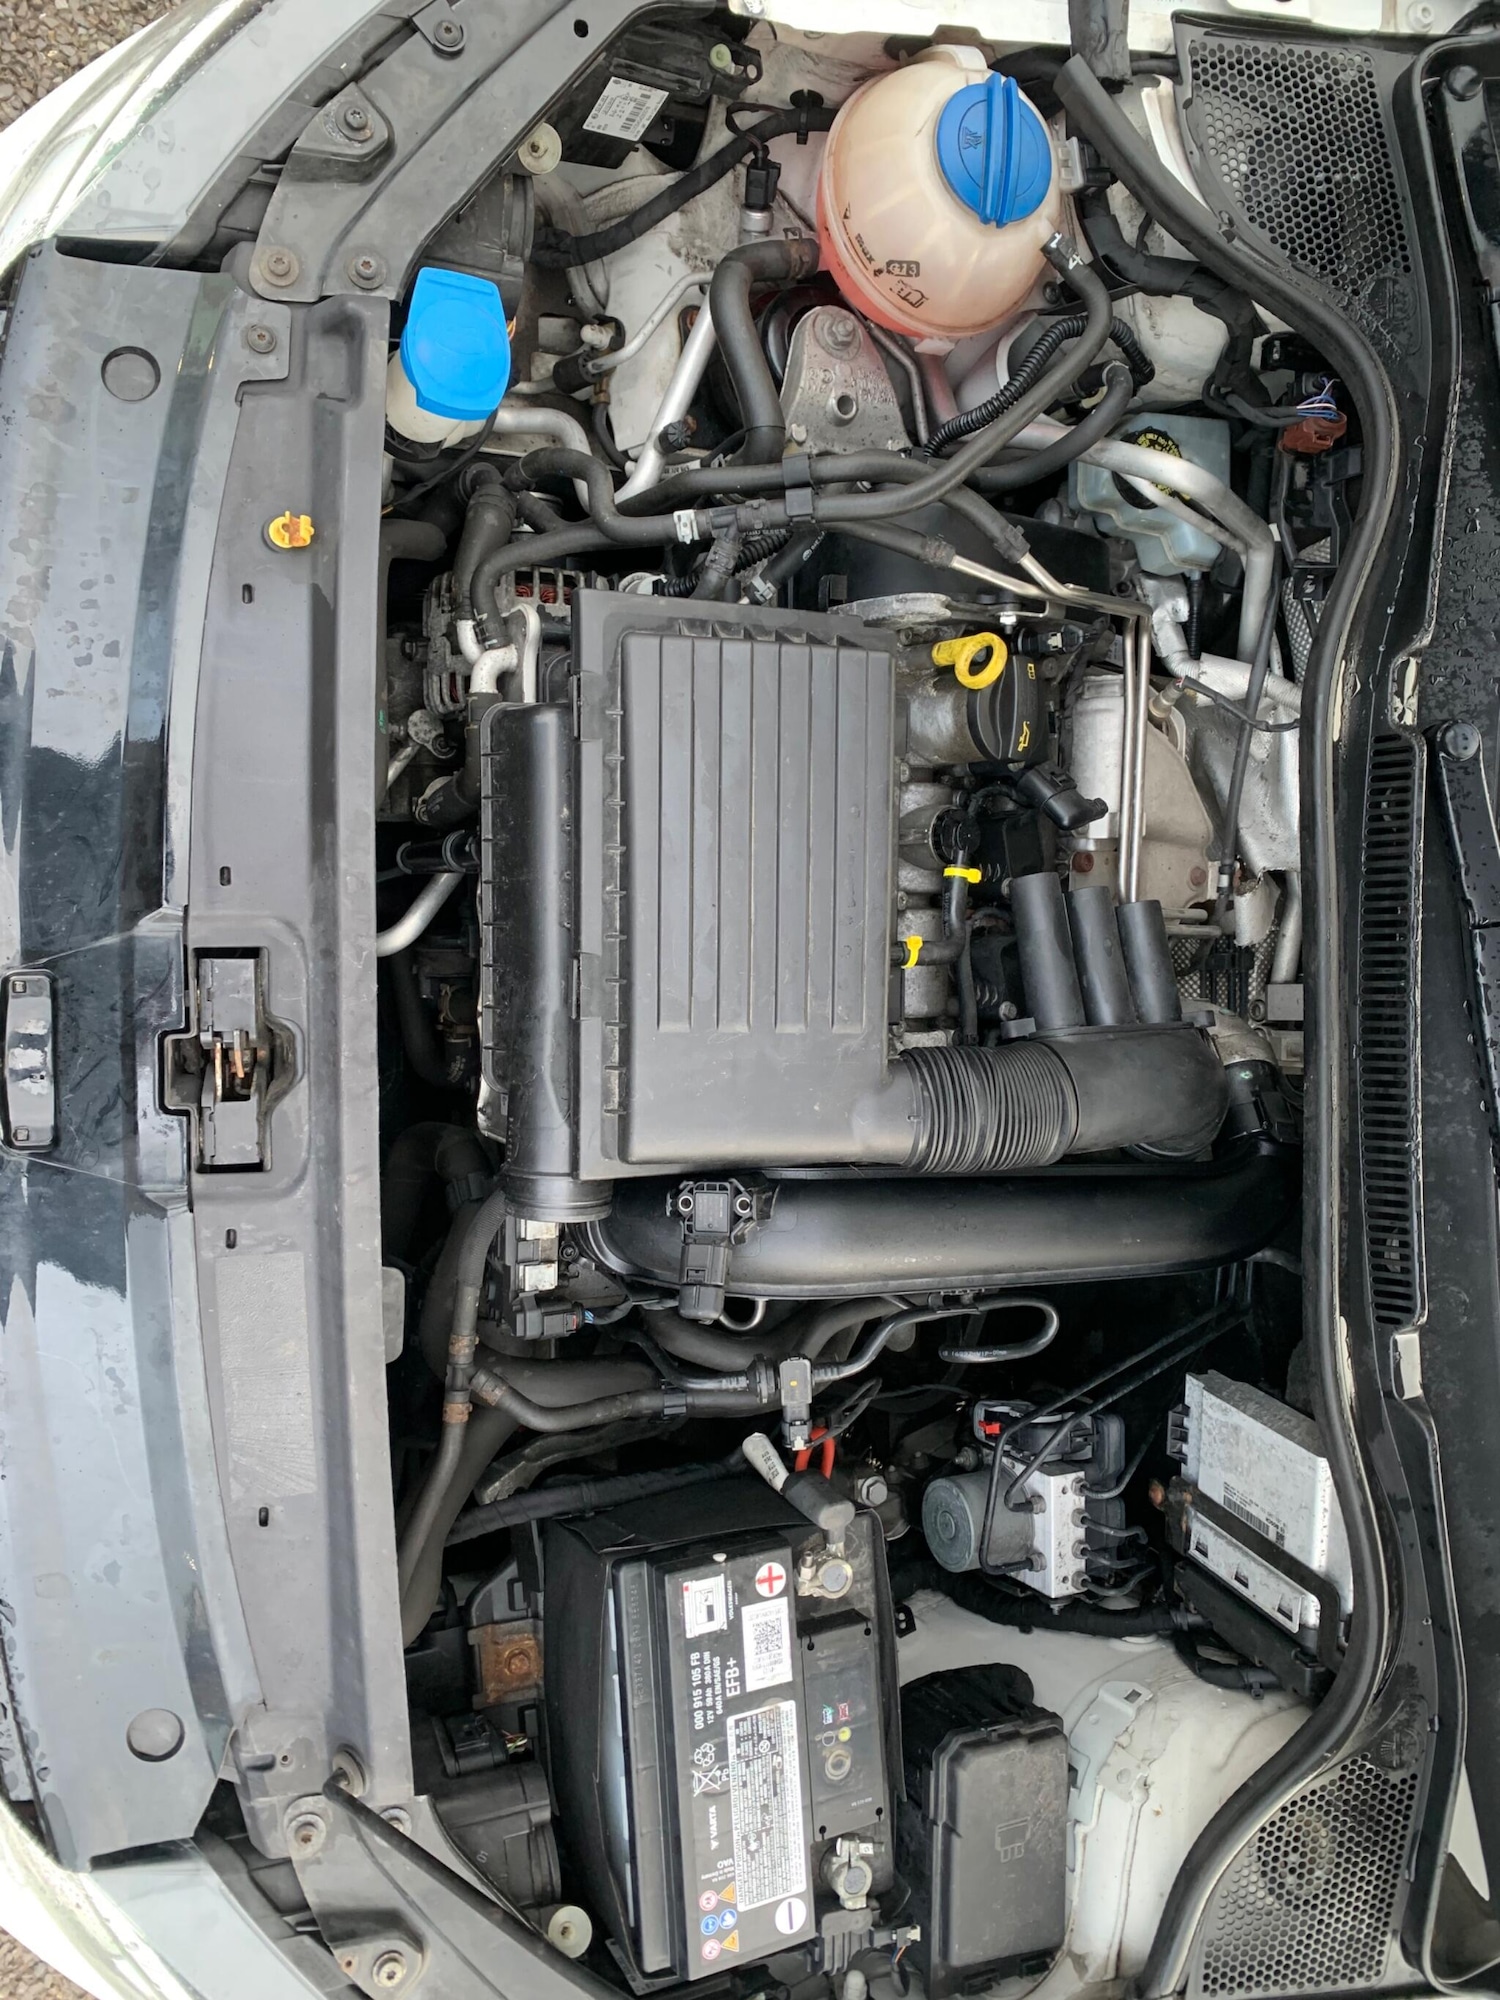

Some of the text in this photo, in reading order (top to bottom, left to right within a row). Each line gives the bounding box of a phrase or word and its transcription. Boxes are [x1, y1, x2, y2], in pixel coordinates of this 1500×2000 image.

[889, 262, 917, 276] G13
[703, 1651, 711, 1665] DIN
[725, 1657, 741, 1698] EFB+
[690, 1651, 704, 1729] 000 915 105 FB
[714, 1693, 723, 1715] 640A
[706, 1709, 715, 1724] 12V
[721, 1768, 730, 1782] Pb
[709, 1805, 717, 1838] VARTA
